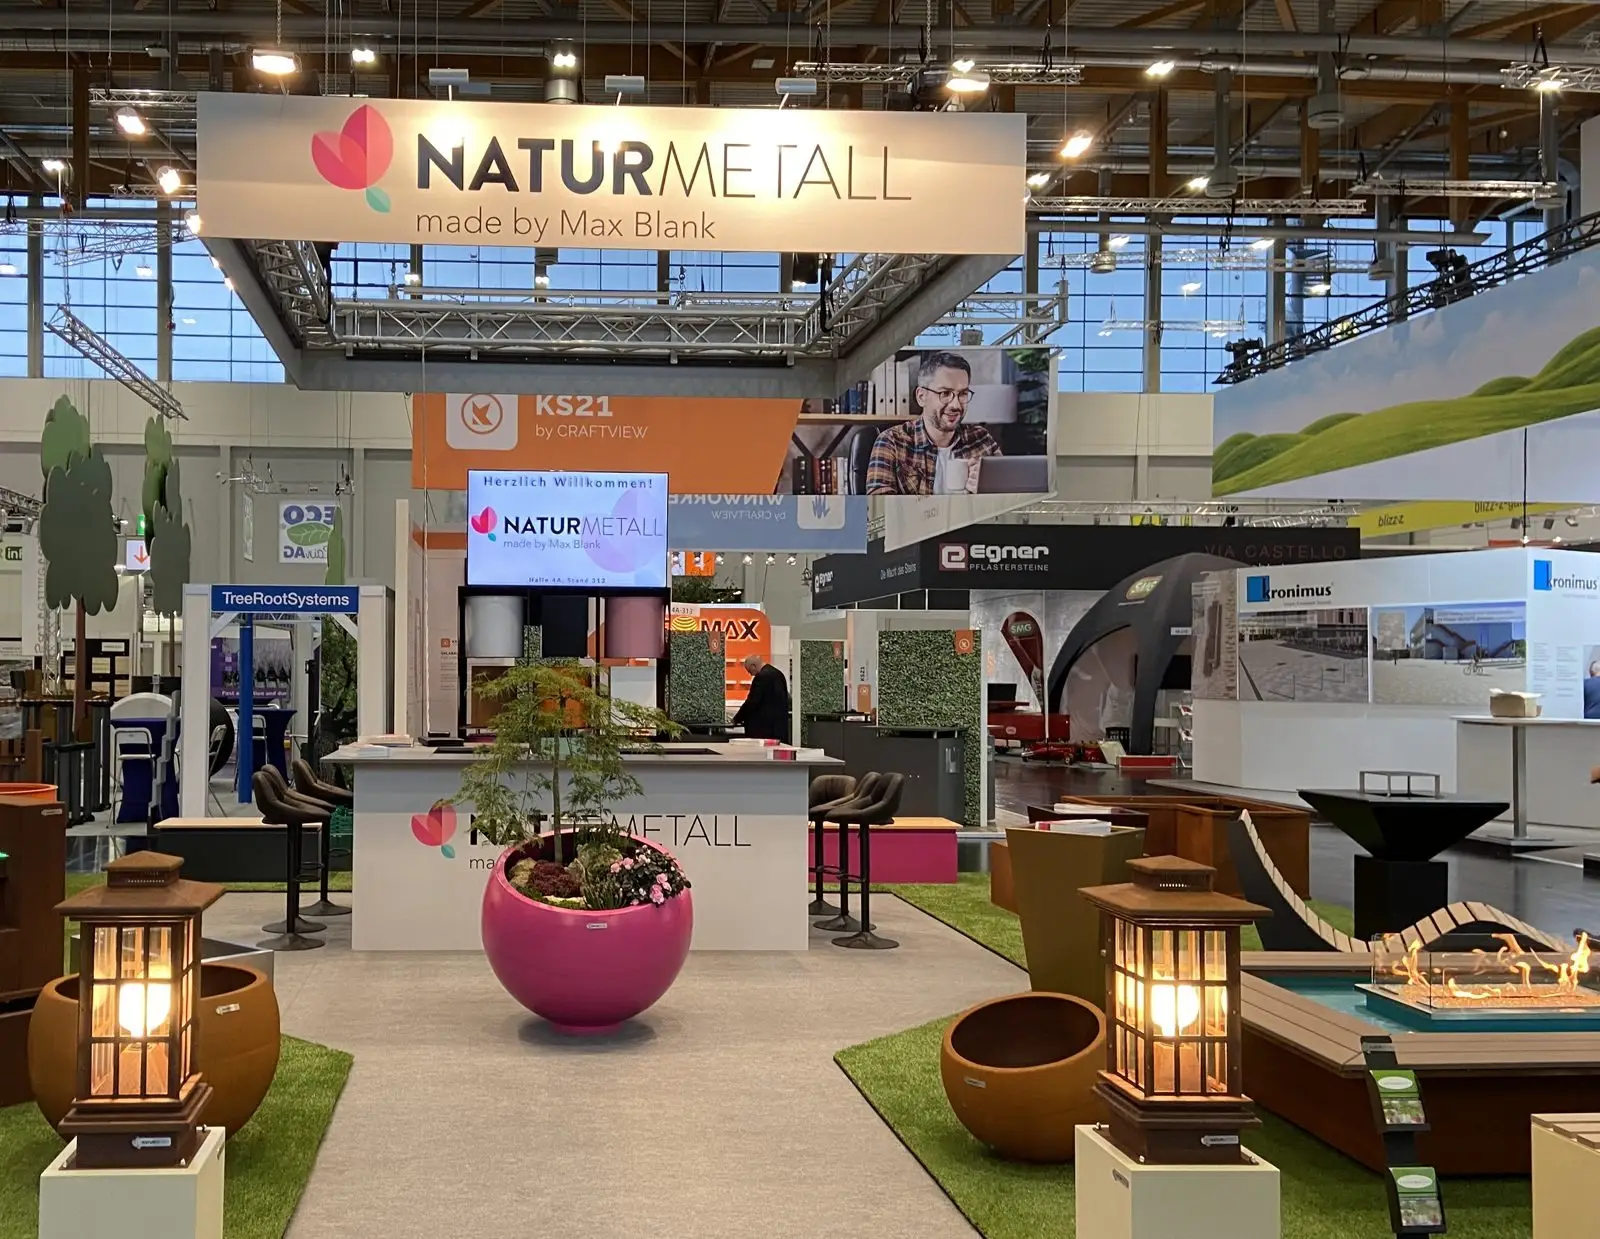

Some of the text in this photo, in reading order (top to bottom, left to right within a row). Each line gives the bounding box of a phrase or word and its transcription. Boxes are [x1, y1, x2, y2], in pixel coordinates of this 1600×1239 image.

[418, 133, 911, 201] NATURMETALL
[416, 208, 716, 242] made by Max Blank
[535, 394, 613, 418] KS21
[535, 425, 648, 440] by CRAFTVIEW
[484, 476, 653, 488] Herzlich Willkommen!
[504, 516, 664, 536] NATURMETALL
[504, 540, 601, 551] made by Max Blank
[970, 544, 1050, 563] Egner
[1245, 545, 1347, 560] CASTELLO
[970, 564, 1049, 572] PFLASTERSTEINE
[1546, 563, 1598, 590] kronimus
[1263, 577, 1332, 599] kronimus
[222, 592, 350, 609] TreeRootSystems
[701, 620, 759, 640] MAX
[1011, 624, 1032, 634] SMG
